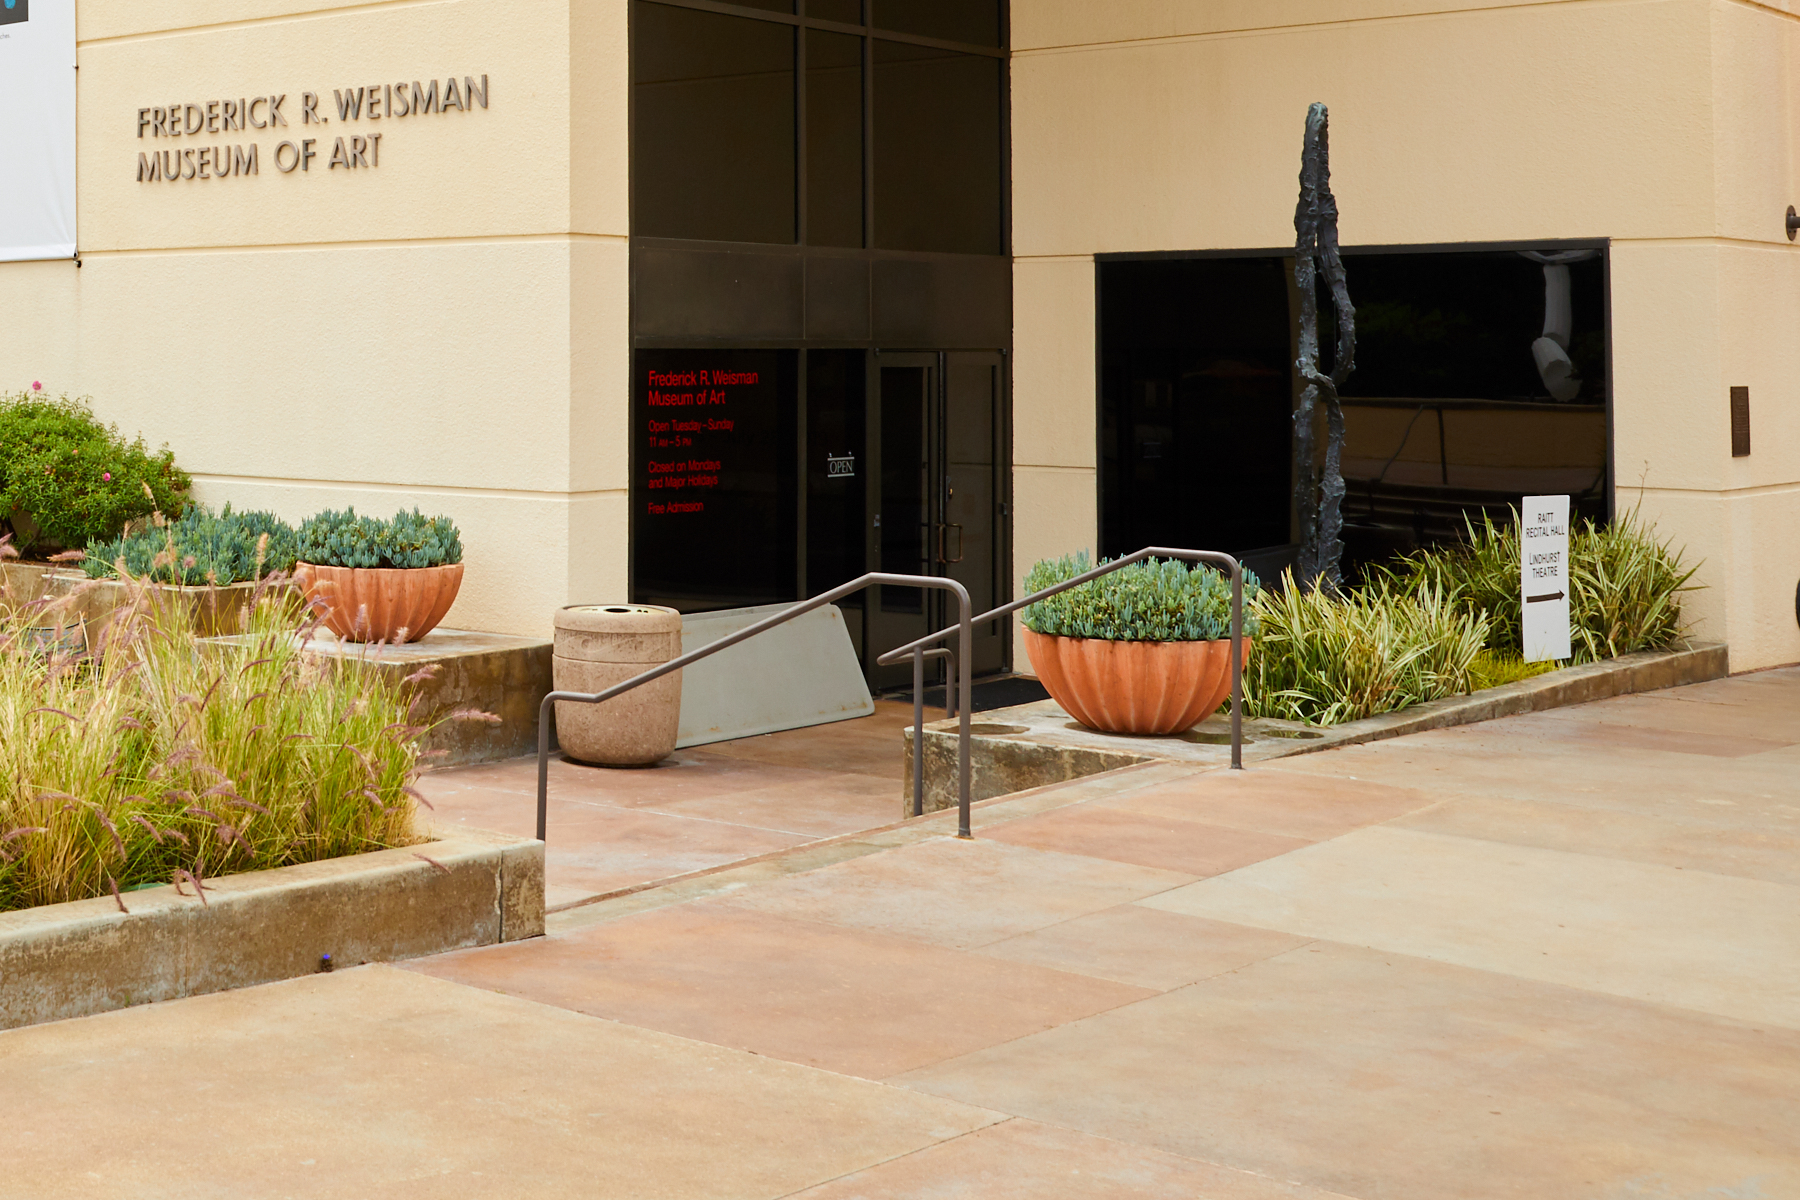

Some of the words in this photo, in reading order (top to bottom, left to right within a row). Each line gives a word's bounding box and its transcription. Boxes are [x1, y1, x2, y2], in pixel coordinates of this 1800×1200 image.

[136, 94, 288, 138] FREDERICK
[301, 91, 328, 124] R.
[333, 74, 489, 121] WEISMAN
[136, 143, 259, 182] MUSEUM
[273, 138, 316, 173] OF
[327, 132, 382, 169] ART
[648, 370, 697, 386] Frederick
[700, 370, 710, 385] R.
[712, 369, 759, 385] Weisman
[648, 390, 693, 406] Museum
[696, 389, 707, 405] of
[709, 389, 726, 404] Art
[648, 420, 670, 434] Open
[649, 436, 656, 447] 11
[682, 438, 692, 446] PM
[648, 460, 674, 473] Closed
[676, 462, 686, 472] on
[688, 459, 721, 472] Mondays
[830, 461, 852, 473] OPEN
[648, 476, 663, 489] and
[664, 475, 686, 490] Major
[688, 474, 718, 488] Holidays
[648, 502, 665, 514] Free
[666, 500, 704, 514] Admission
[1538, 512, 1554, 523] RAITT
[1526, 526, 1549, 538] RECITAL
[1551, 525, 1565, 536] HALL
[1529, 552, 1560, 565] LINDHURST
[1532, 566, 1558, 578] THEATRE
